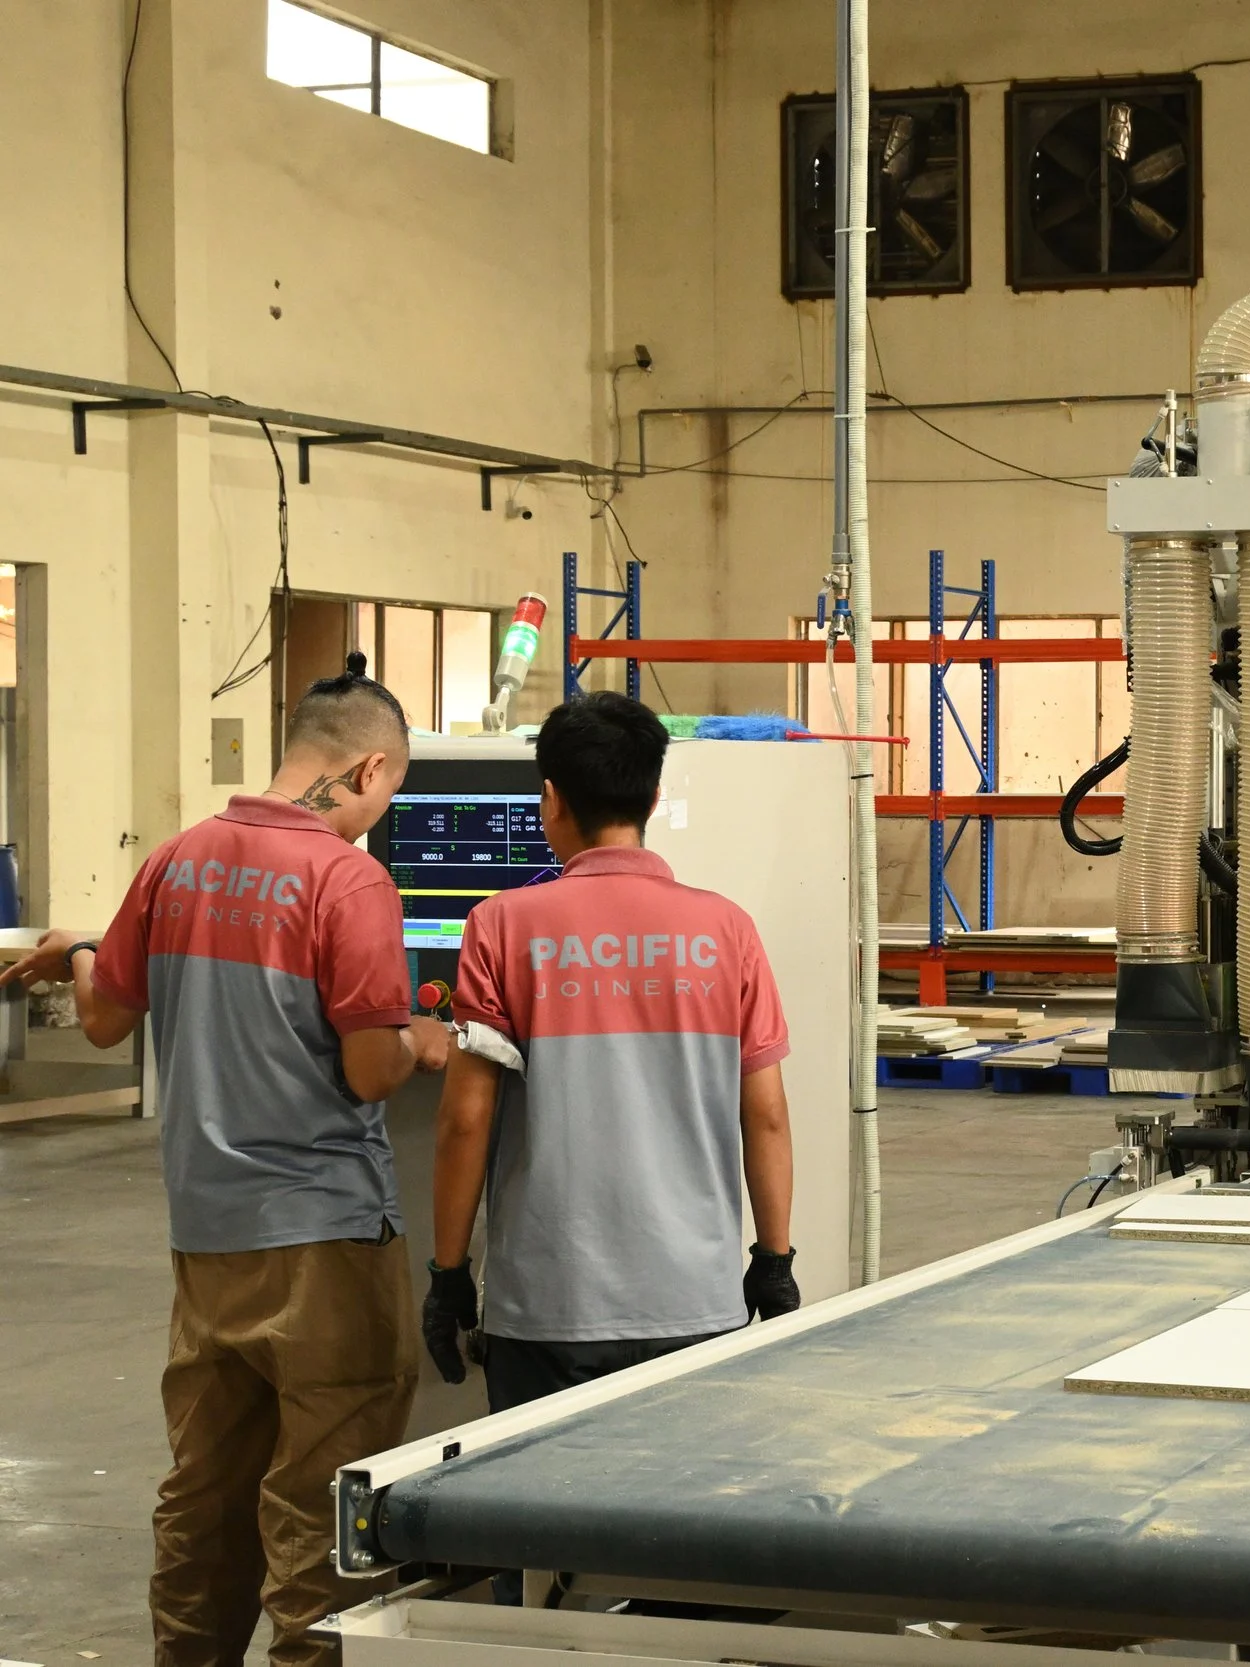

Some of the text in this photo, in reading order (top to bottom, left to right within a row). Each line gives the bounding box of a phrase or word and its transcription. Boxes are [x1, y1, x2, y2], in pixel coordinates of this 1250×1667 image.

[163, 858, 303, 906] PACIFIC
[152, 901, 290, 933] JONERY
[529, 933, 718, 971] PACIFIC
[535, 979, 716, 1000] JOINERY
